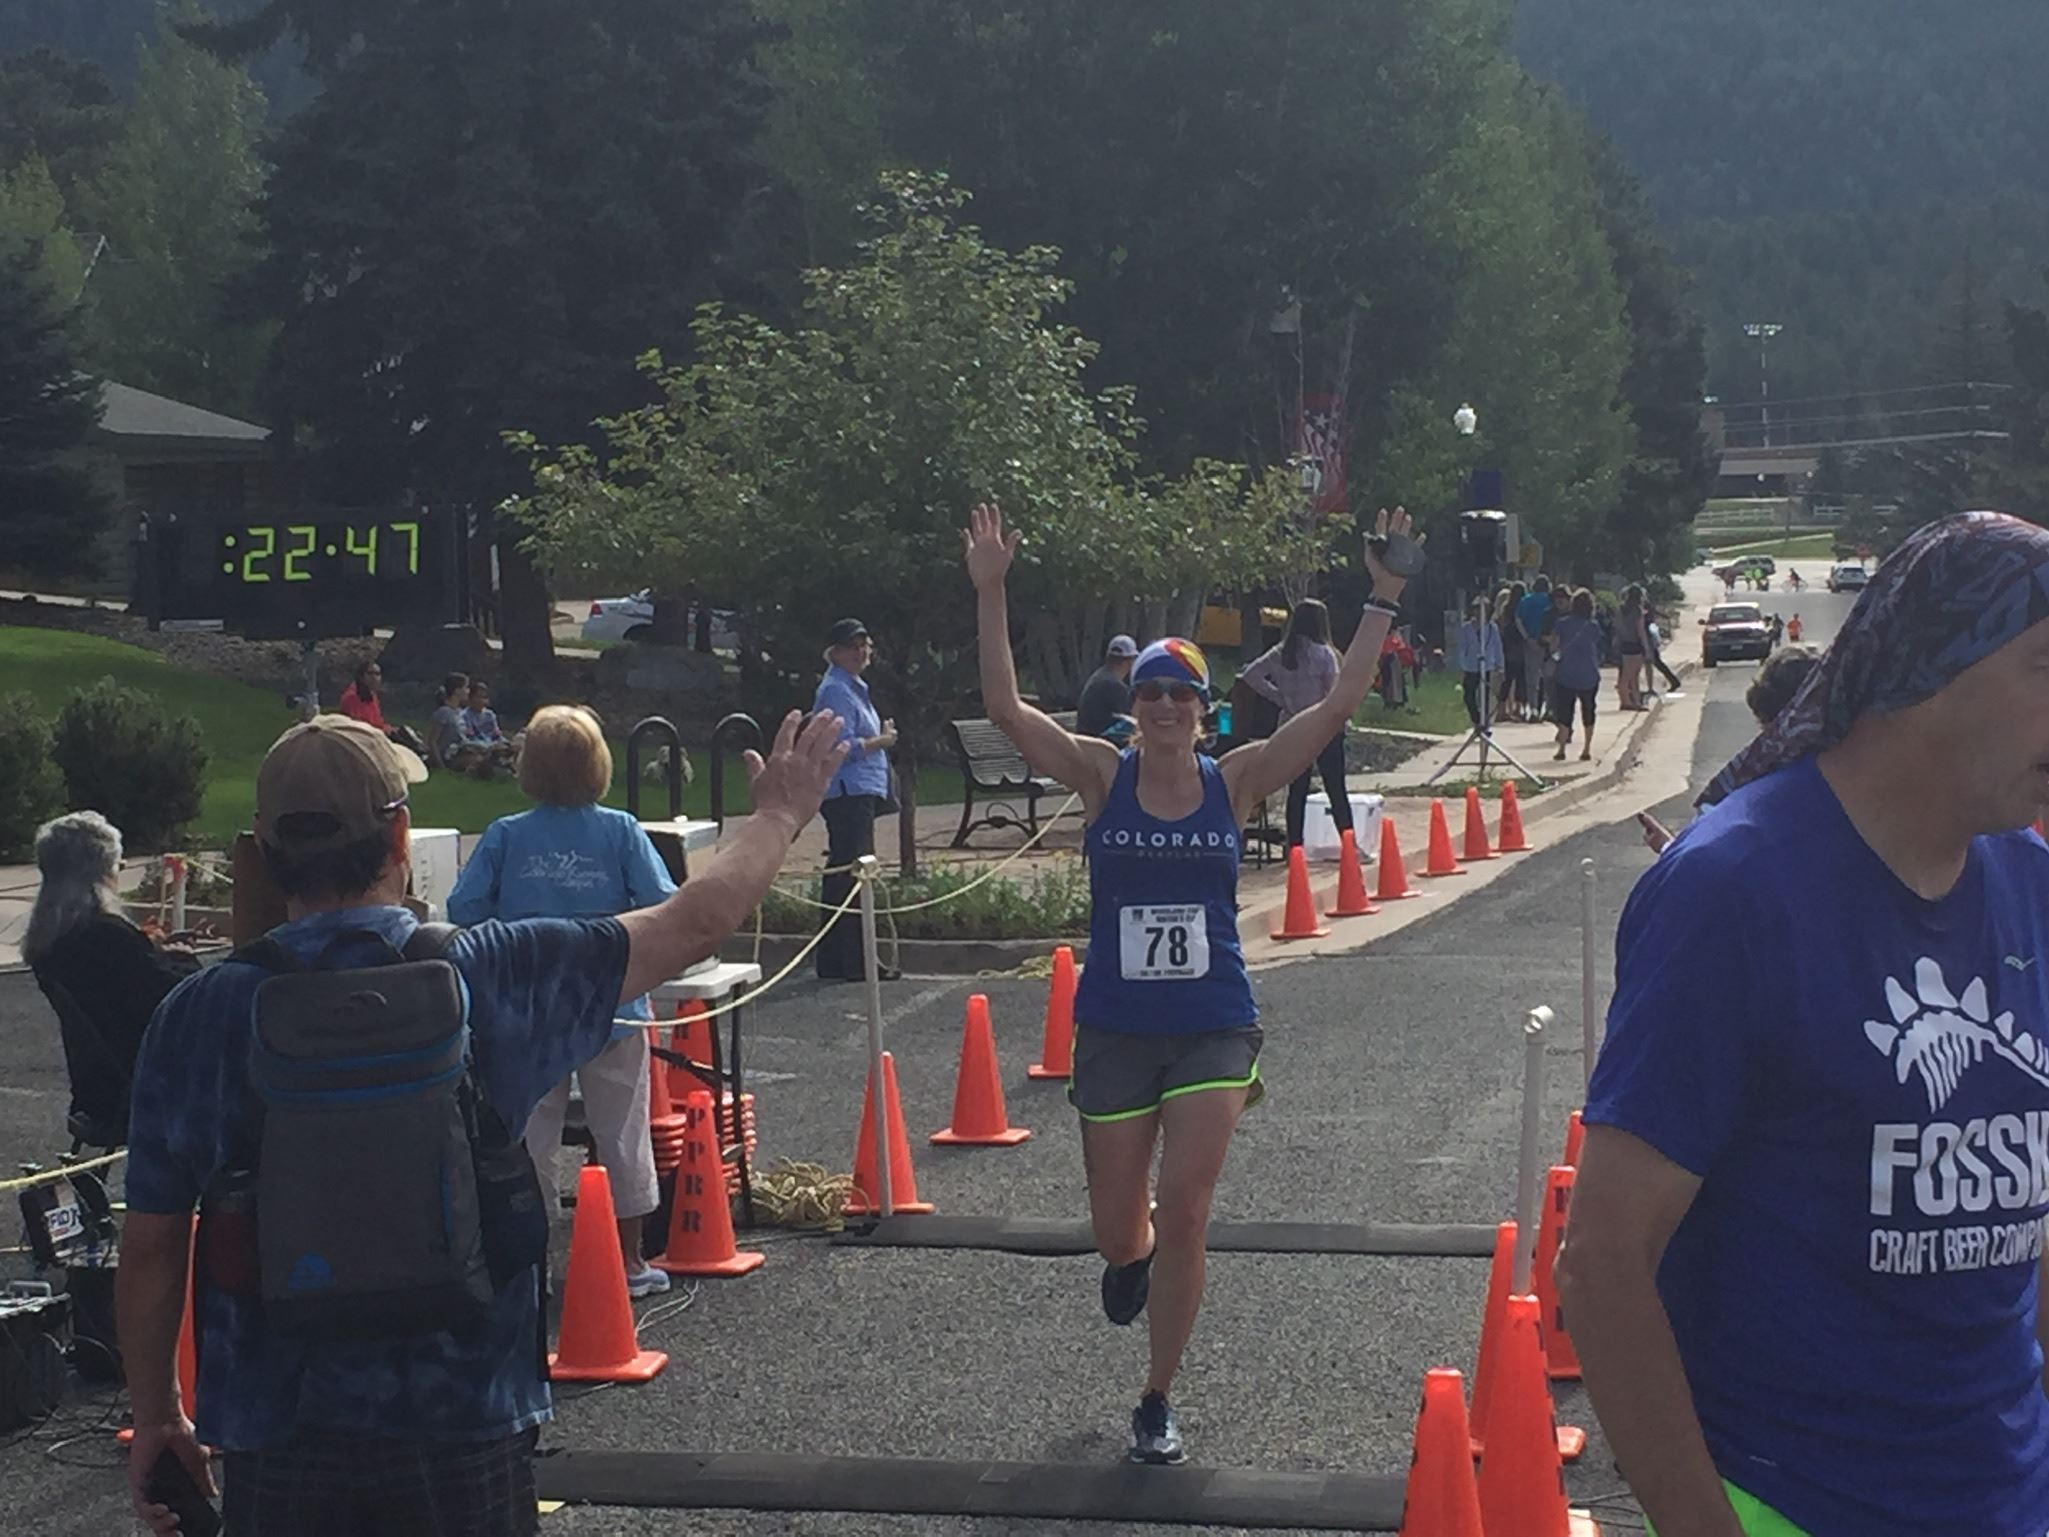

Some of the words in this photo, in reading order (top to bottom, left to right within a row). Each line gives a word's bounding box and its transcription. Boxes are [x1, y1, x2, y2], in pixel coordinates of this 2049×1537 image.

[1102, 830, 1235, 848] COLORADO
[1145, 926, 1188, 967] 78
[1869, 1229, 1939, 1274] CRAFT
[1944, 1226, 1989, 1271] BEER
